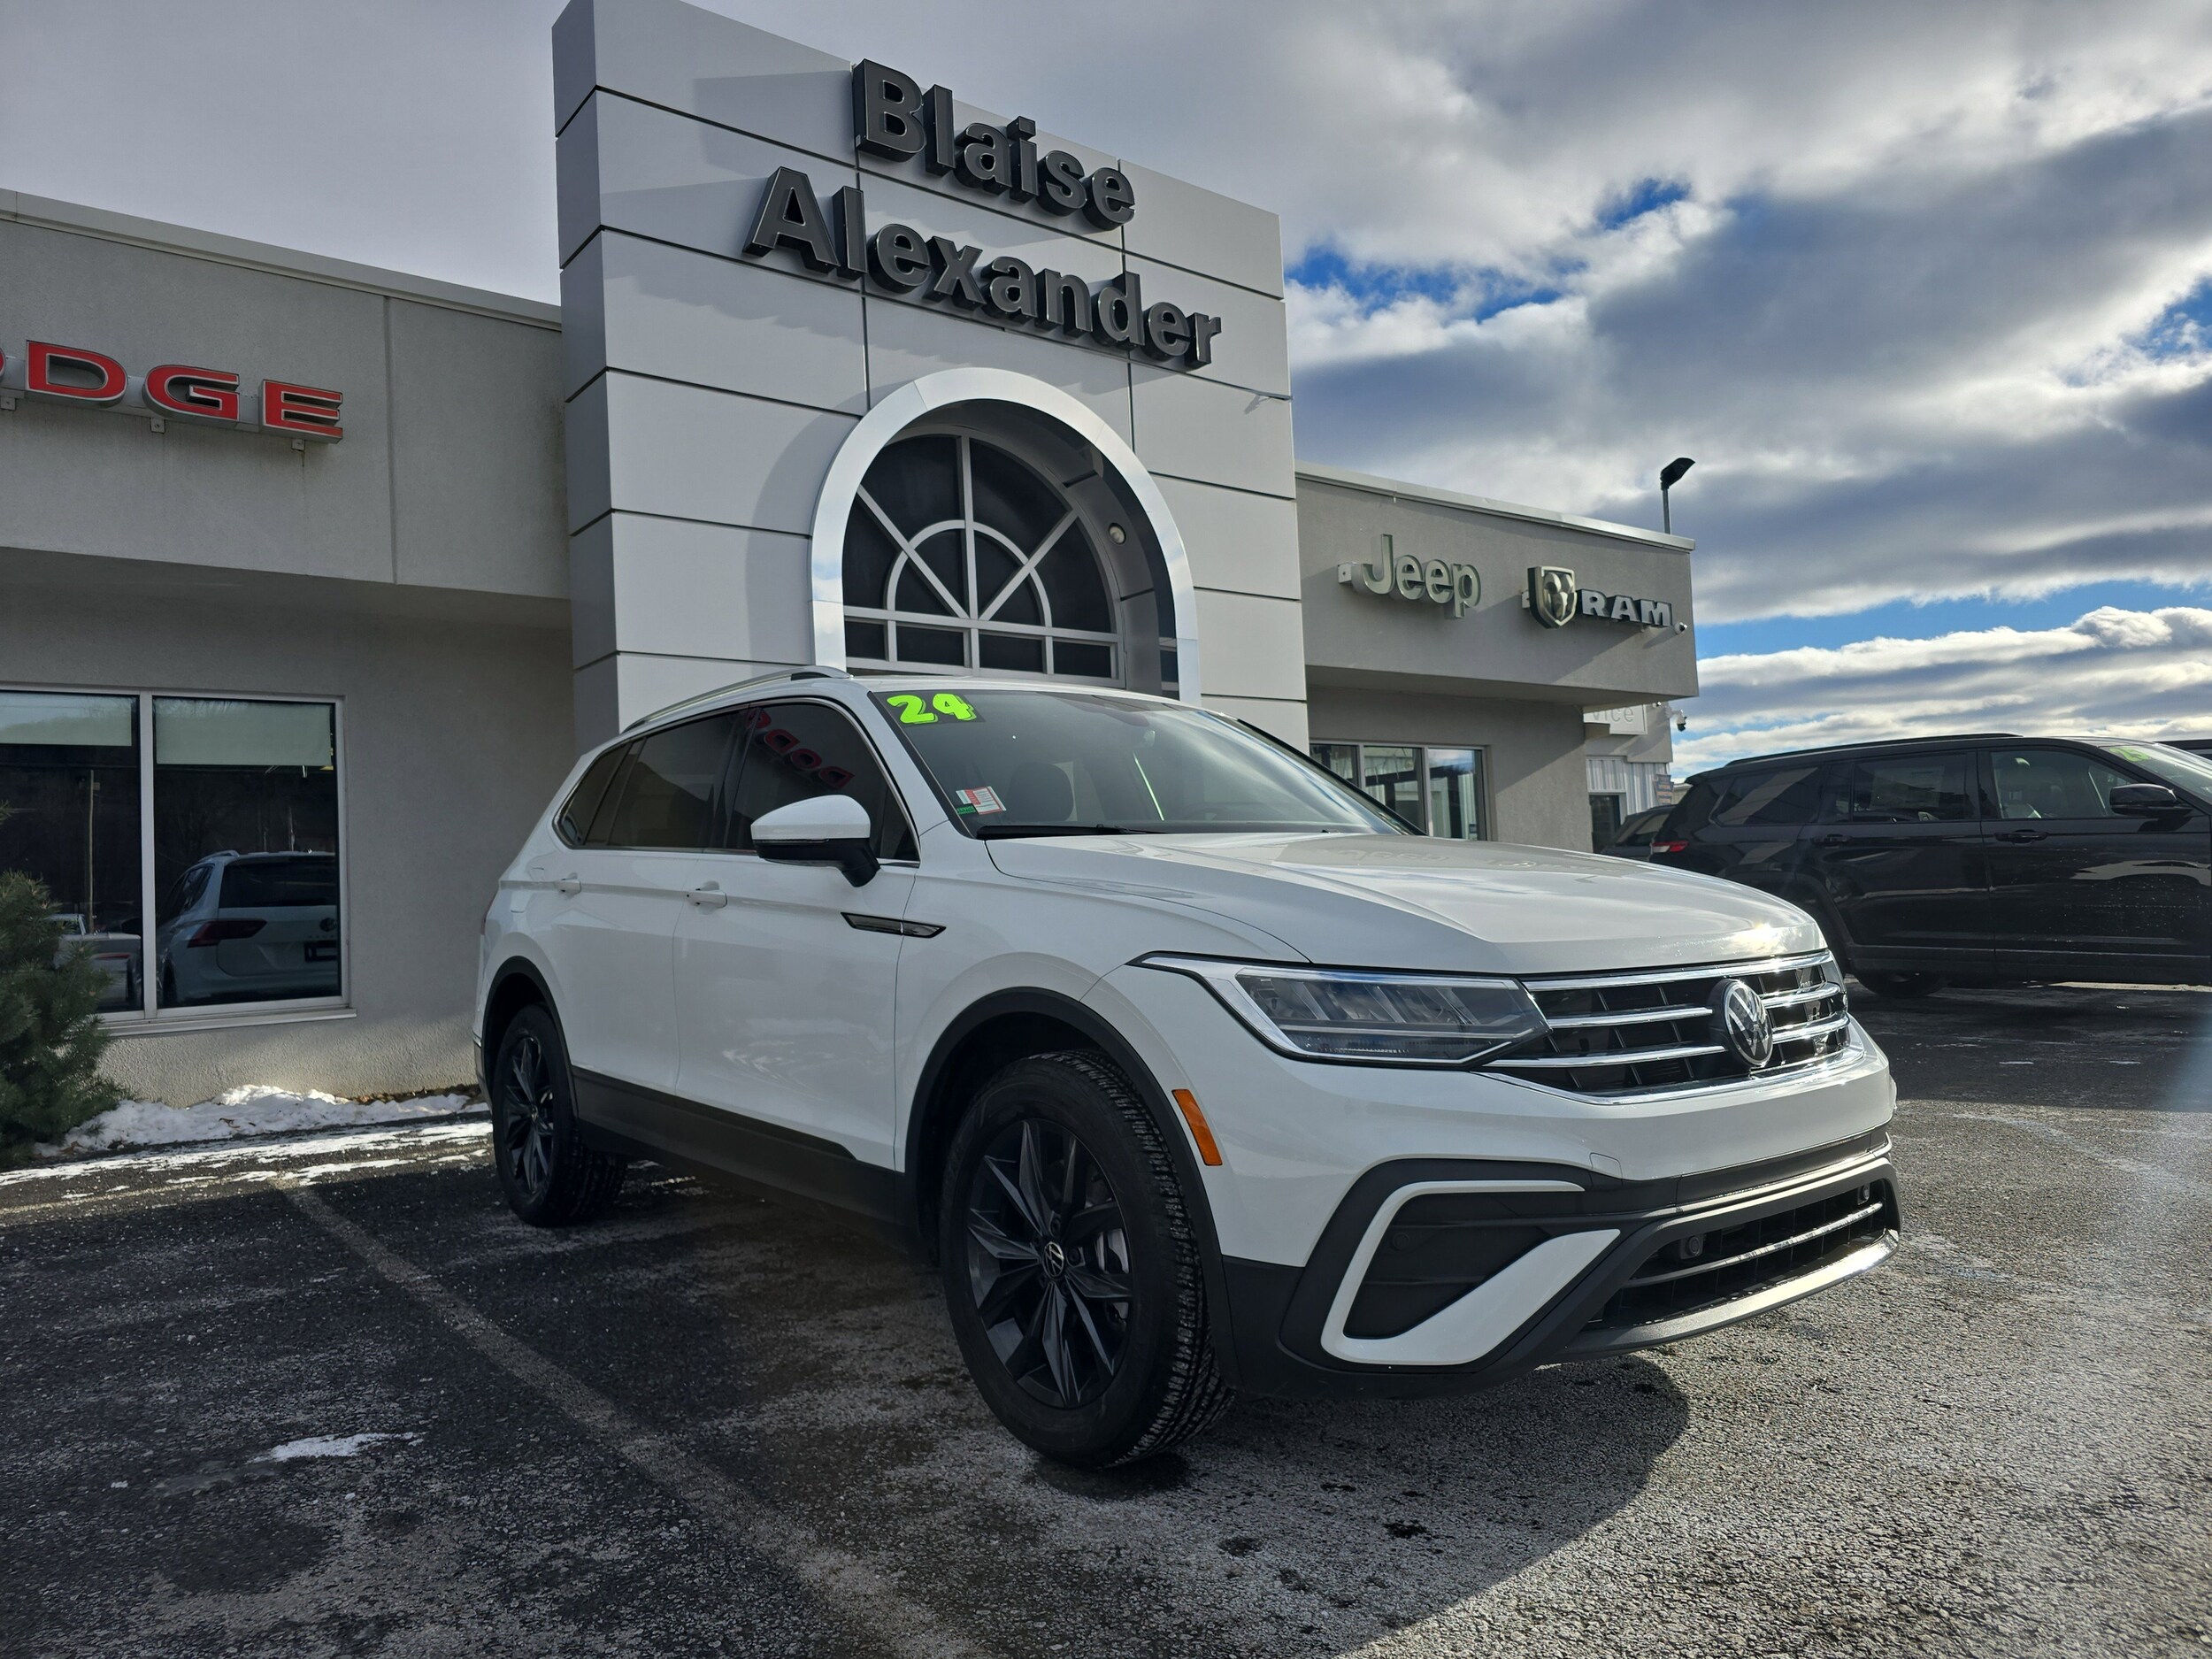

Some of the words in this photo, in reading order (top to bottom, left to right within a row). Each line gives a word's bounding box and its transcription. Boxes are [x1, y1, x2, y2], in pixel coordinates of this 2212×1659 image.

[853, 58, 1135, 230] Blaise
[743, 166, 1221, 368] Alexander
[0, 340, 343, 444] DGE
[1360, 534, 1481, 618] Jeep
[1578, 588, 1672, 627] RAM
[887, 693, 977, 724] 24
